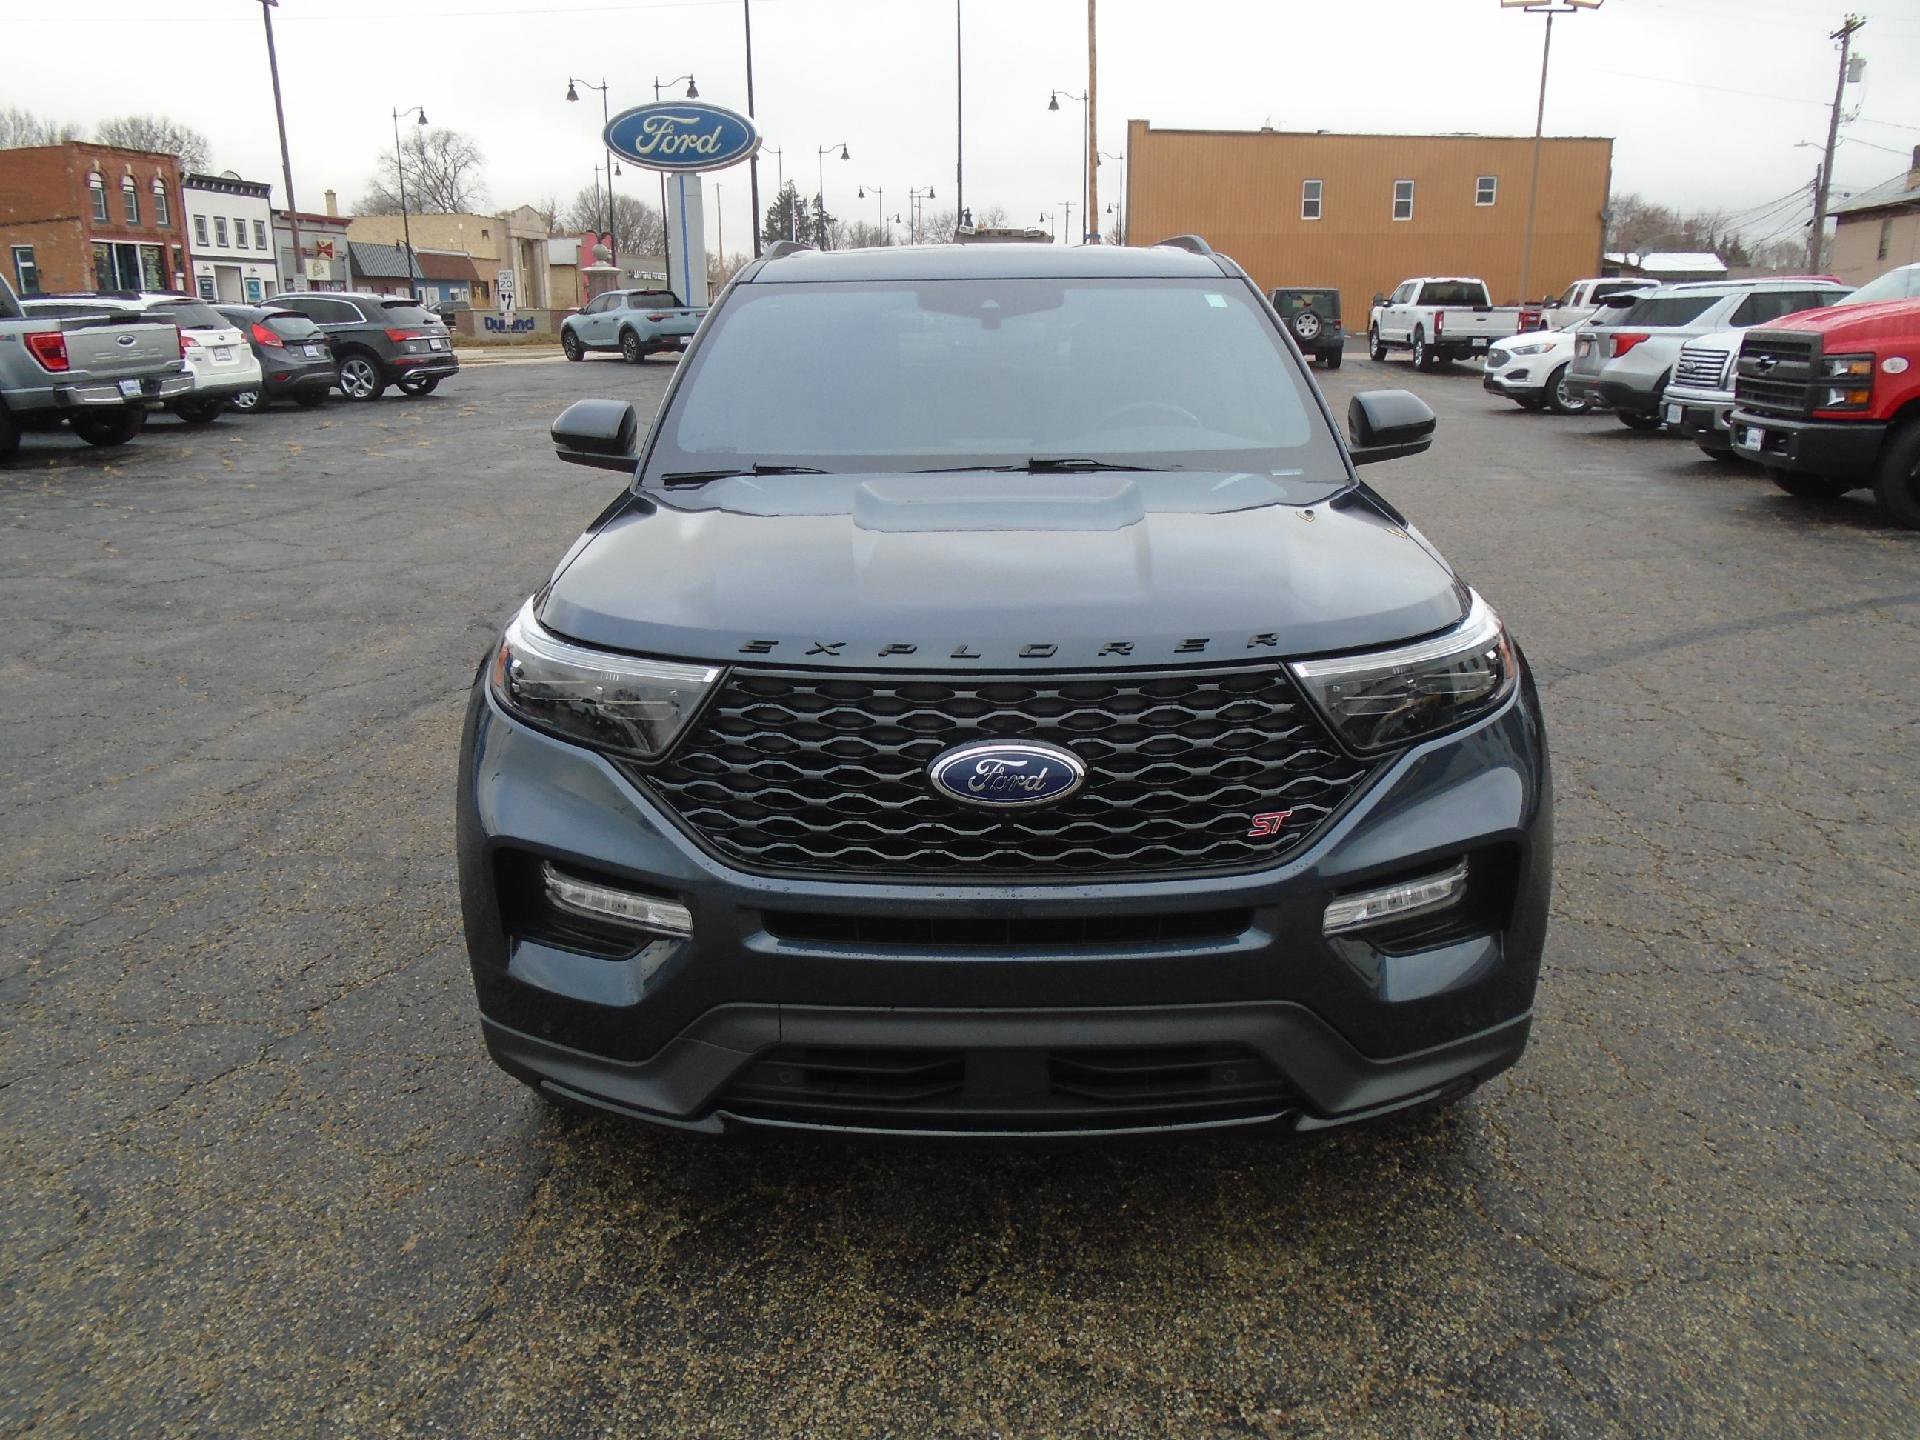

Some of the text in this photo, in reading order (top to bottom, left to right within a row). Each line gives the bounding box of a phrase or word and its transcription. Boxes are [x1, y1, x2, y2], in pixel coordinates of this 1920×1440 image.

[635, 115, 722, 154] Ford
[739, 632, 1279, 659] EXPLORER
[967, 759, 1048, 792] Ford
[1247, 810, 1293, 837] ST
